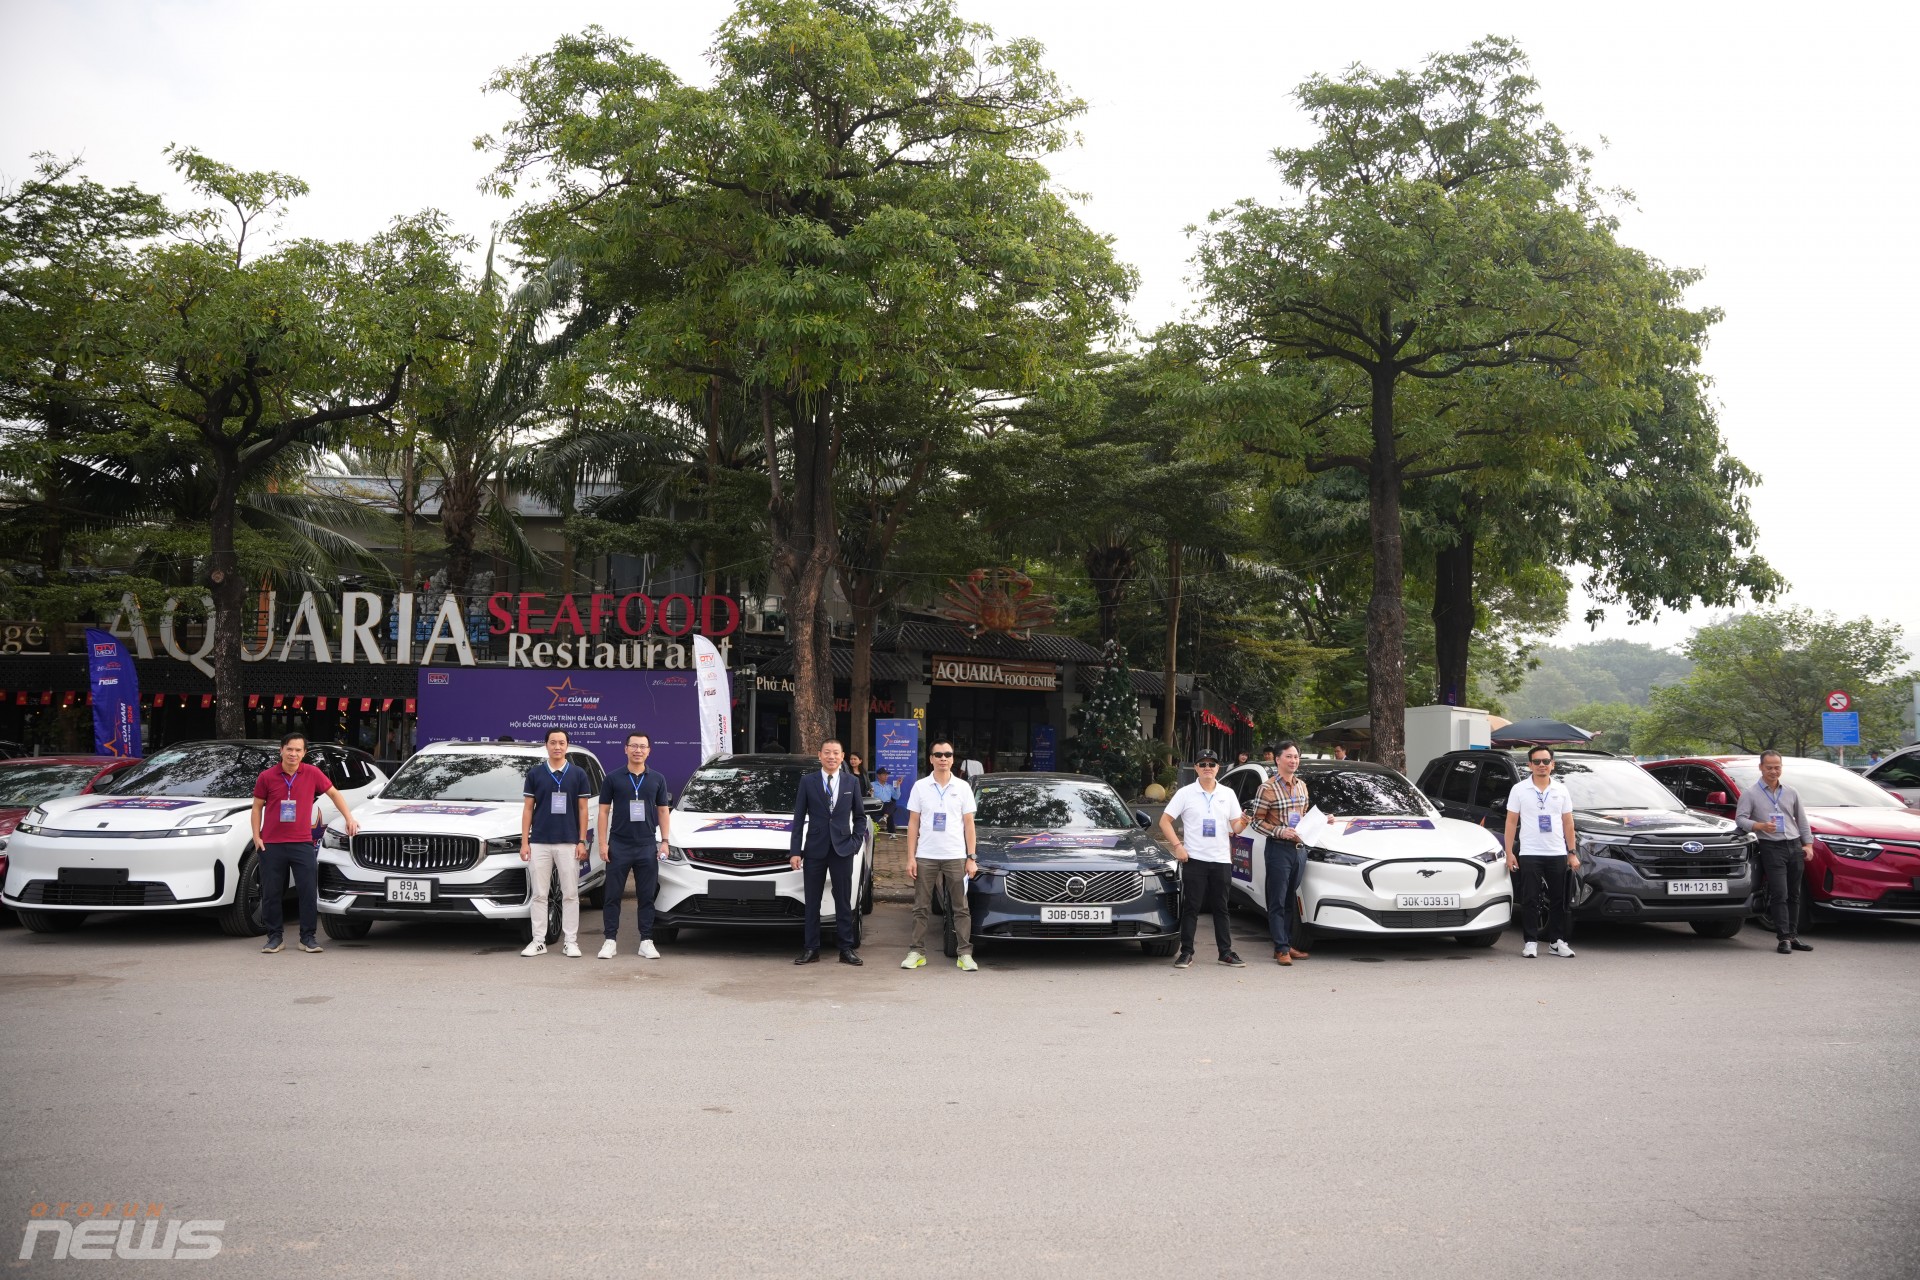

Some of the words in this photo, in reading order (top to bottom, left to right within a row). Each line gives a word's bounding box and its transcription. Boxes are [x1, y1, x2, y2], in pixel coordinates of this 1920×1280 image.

[487, 591, 740, 637] SEAFOOD
[0, 625, 43, 654] ge
[108, 590, 476, 679] AQUARIA
[508, 632, 733, 669] Restaurat
[936, 662, 1003, 683] AQUARIA
[1004, 674, 1027, 686] FOOD
[1029, 675, 1056, 688] CENTRE
[833, 698, 850, 712] NH
[869, 696, 896, 713] ÀNG
[557, 713, 576, 721] TRÌNH
[913, 708, 925, 719] 29
[510, 721, 521, 729] HỘI
[522, 720, 541, 728] ĐỒNG
[560, 721, 578, 729] KHẢO
[588, 721, 602, 729] CỦA
[603, 721, 618, 729] NĂM
[399, 880, 418, 891] 89A
[391, 891, 426, 901] 814.95
